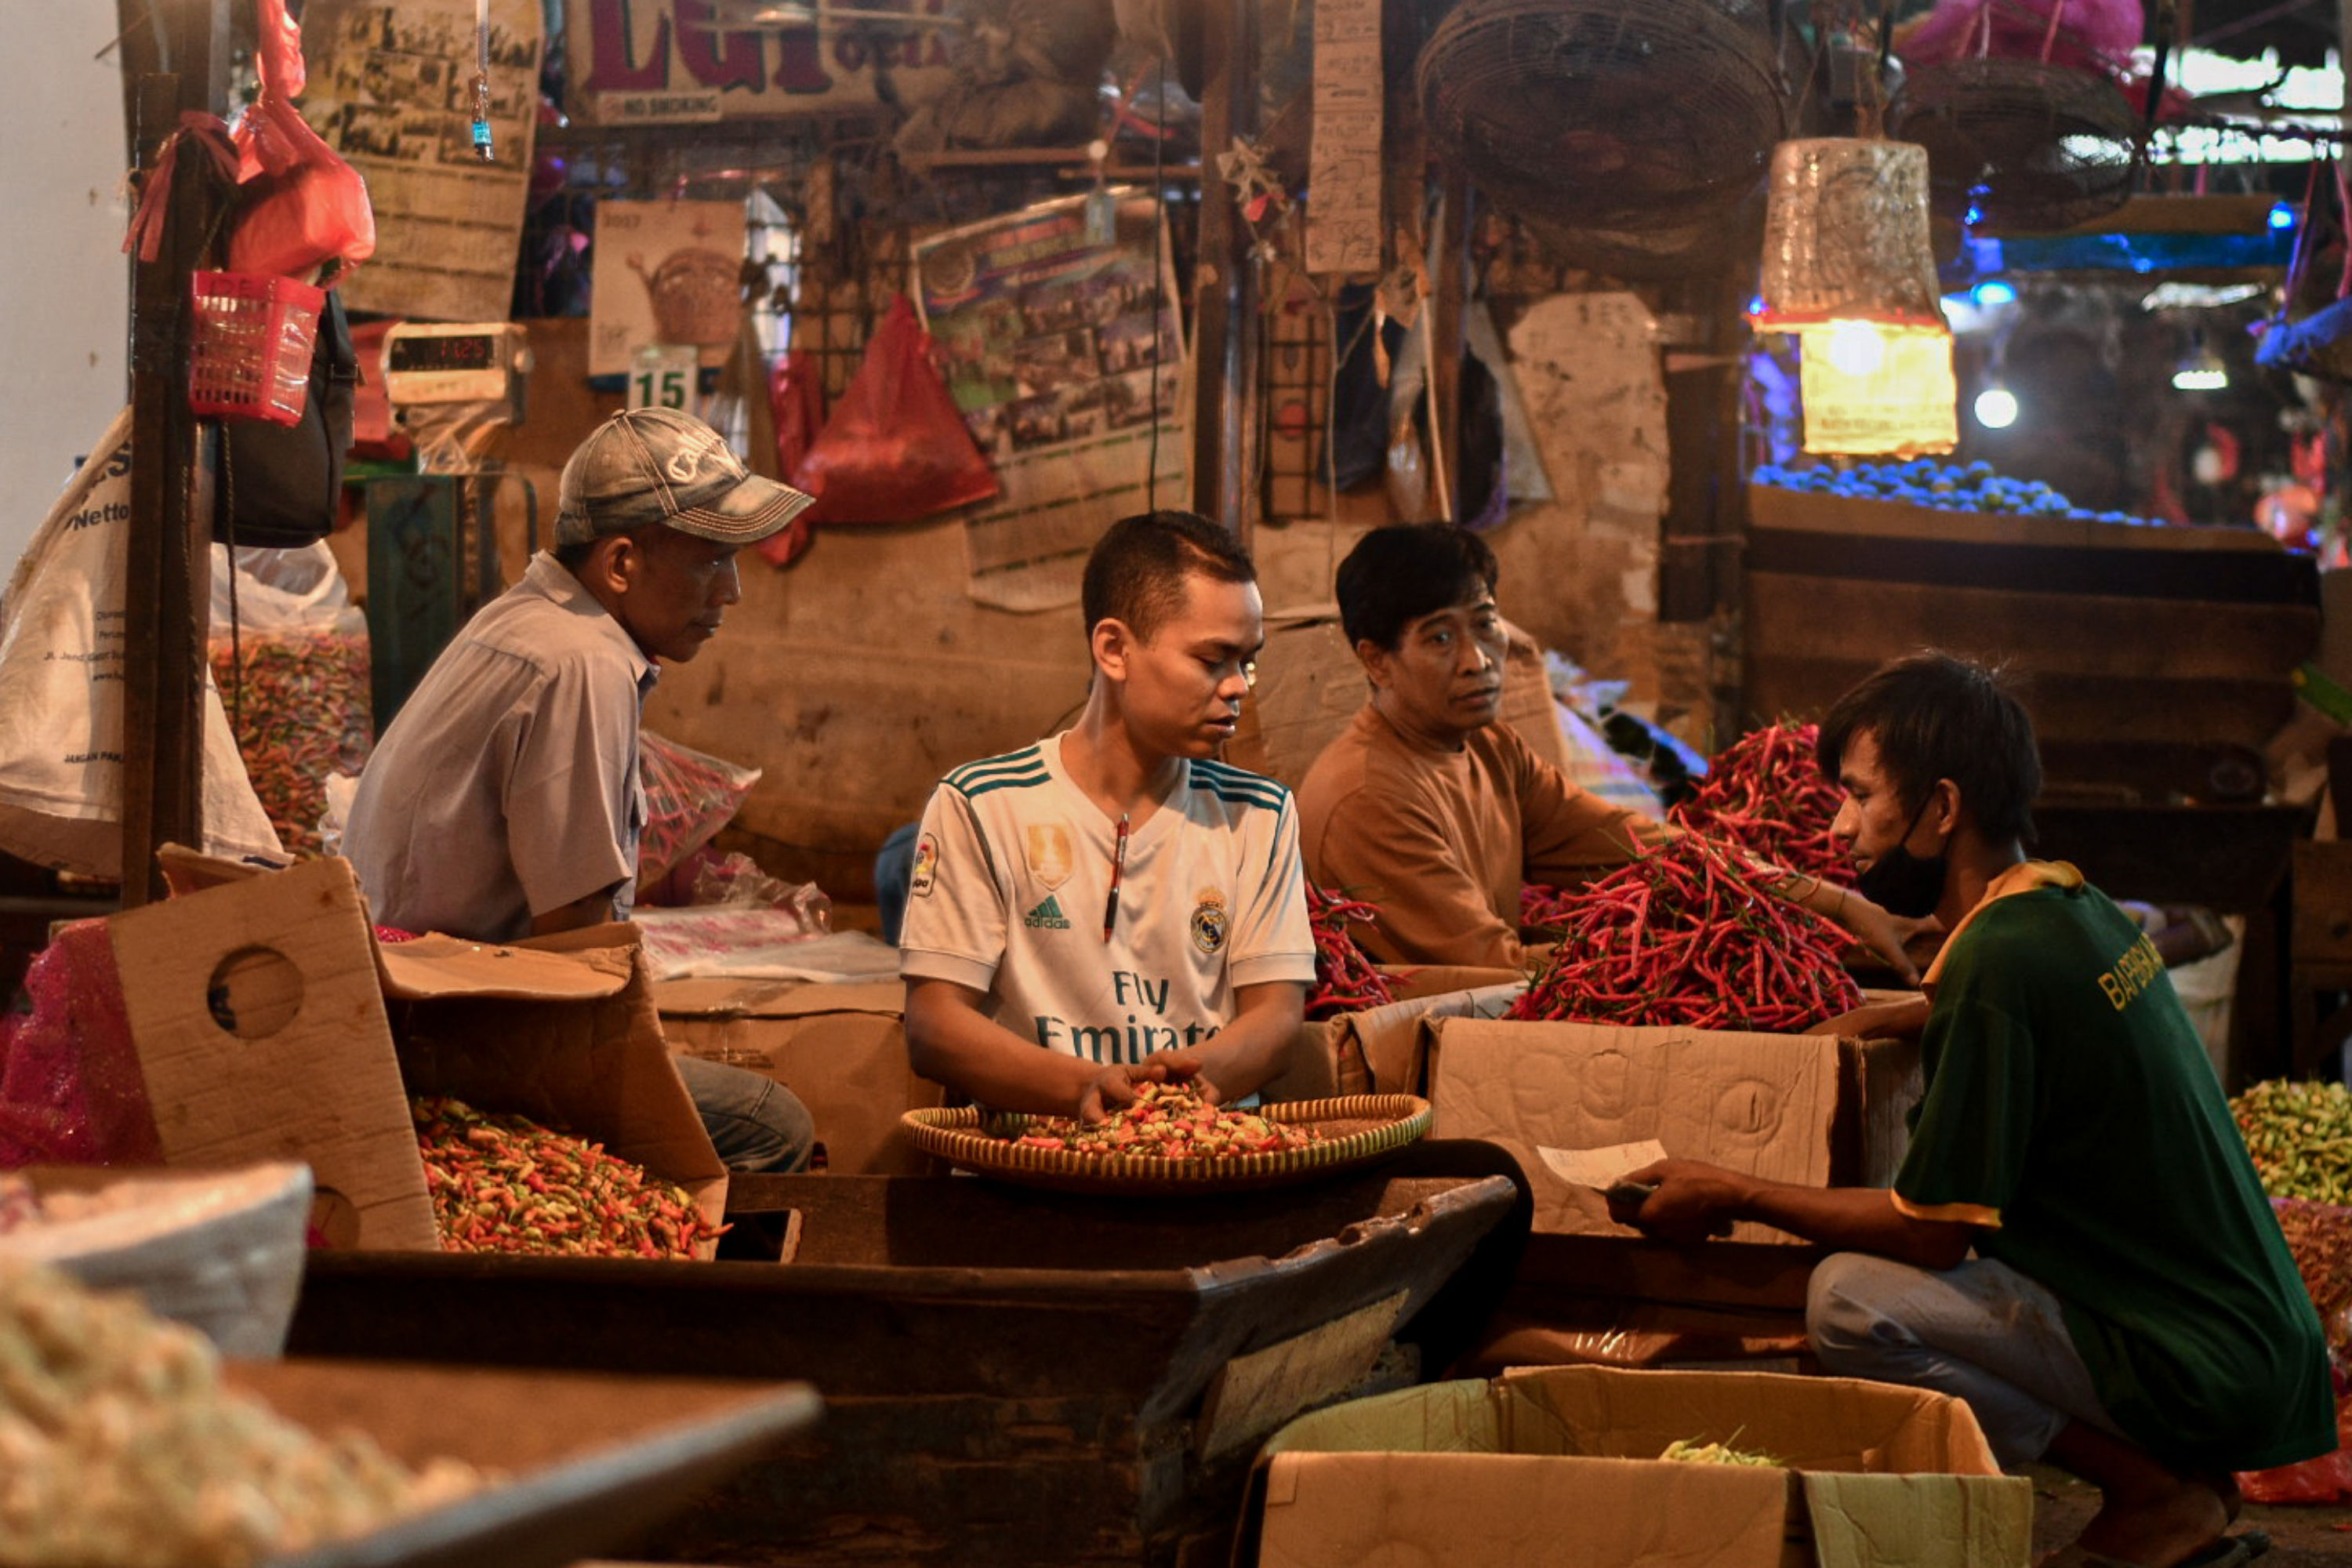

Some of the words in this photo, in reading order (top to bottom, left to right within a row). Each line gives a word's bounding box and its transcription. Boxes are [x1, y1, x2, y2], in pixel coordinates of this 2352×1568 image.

[624, 98, 645, 116] NO
[649, 96, 718, 116] SMOKING
[636, 372, 685, 410] 15
[74, 502, 129, 532] Netto
[1025, 915, 1070, 930] adidas
[1112, 970, 1170, 1015] Fly
